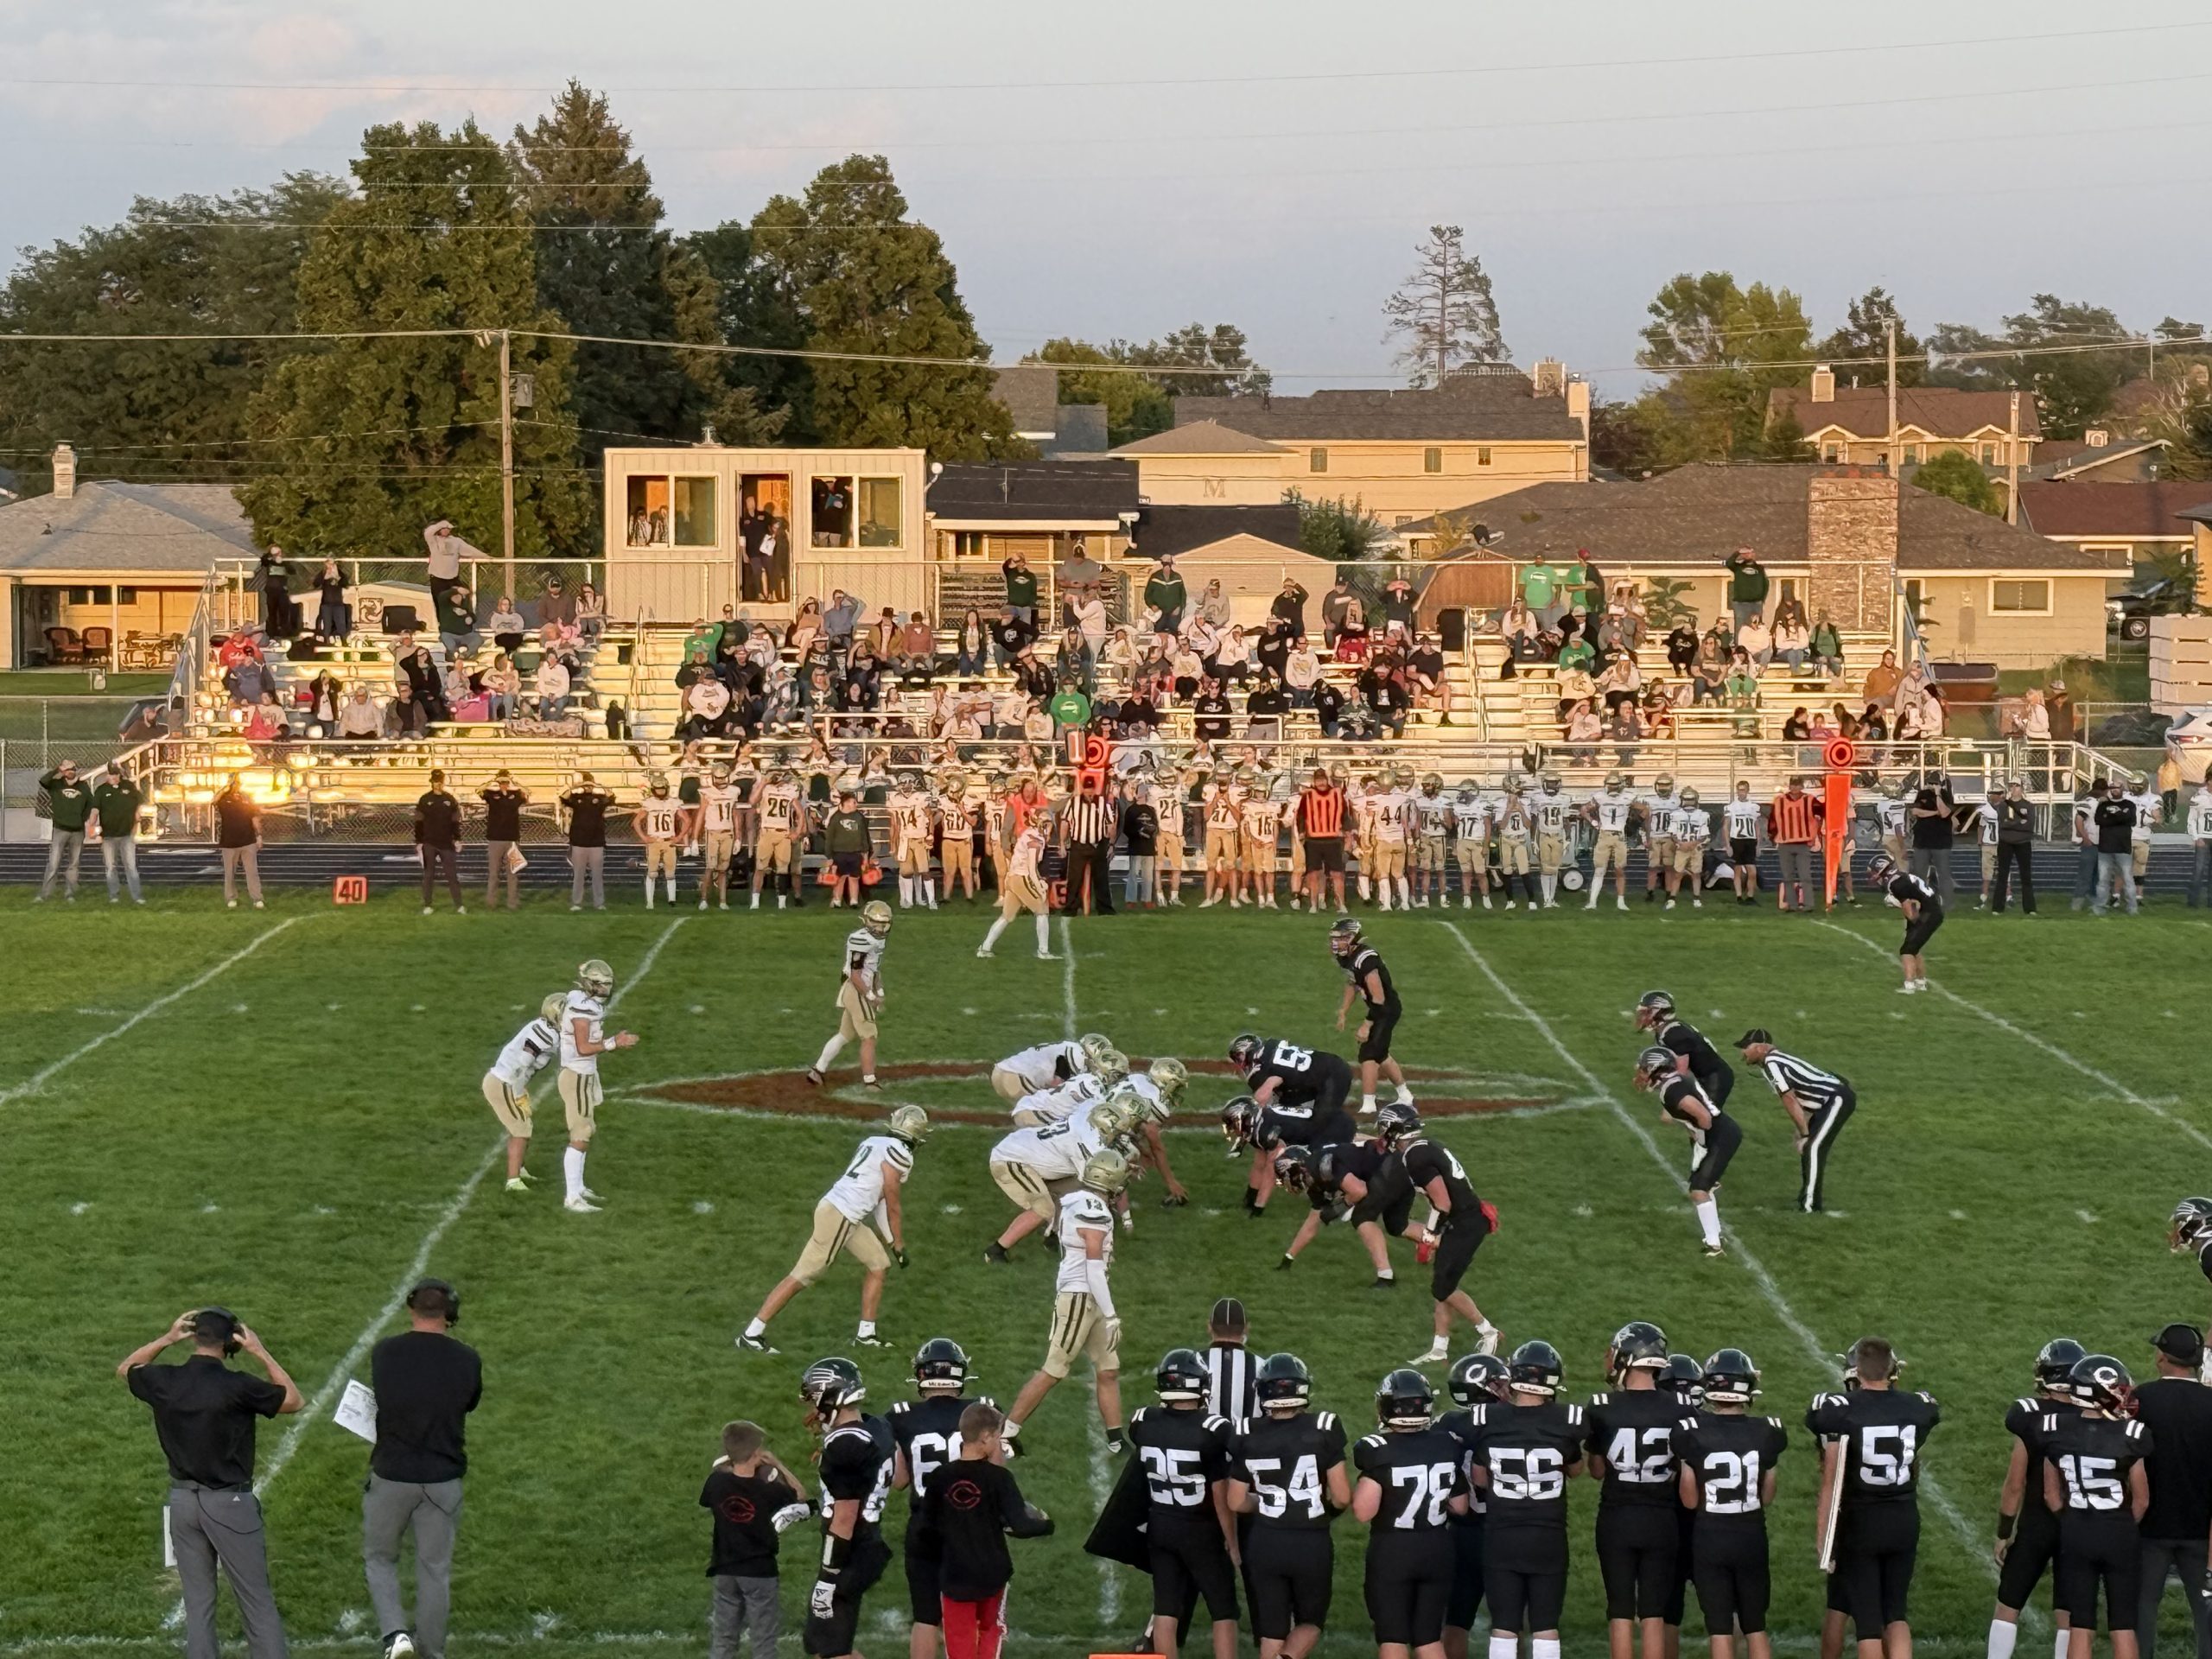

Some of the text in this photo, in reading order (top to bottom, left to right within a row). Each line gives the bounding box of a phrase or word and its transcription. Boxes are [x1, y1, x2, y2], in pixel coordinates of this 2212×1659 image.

[1204, 478, 1226, 499] M
[654, 810, 672, 833] 16
[1734, 816, 1755, 839] 20
[338, 880, 363, 903] 40
[1488, 1446, 1564, 1500] 56
[1607, 1427, 1675, 1484] 42
[1703, 1450, 1762, 1514] 21
[1860, 1423, 1916, 1486] 51
[2059, 1453, 2124, 1510] 15
[1245, 1453, 1325, 1519] 54
[1391, 1460, 1456, 1529] 78
